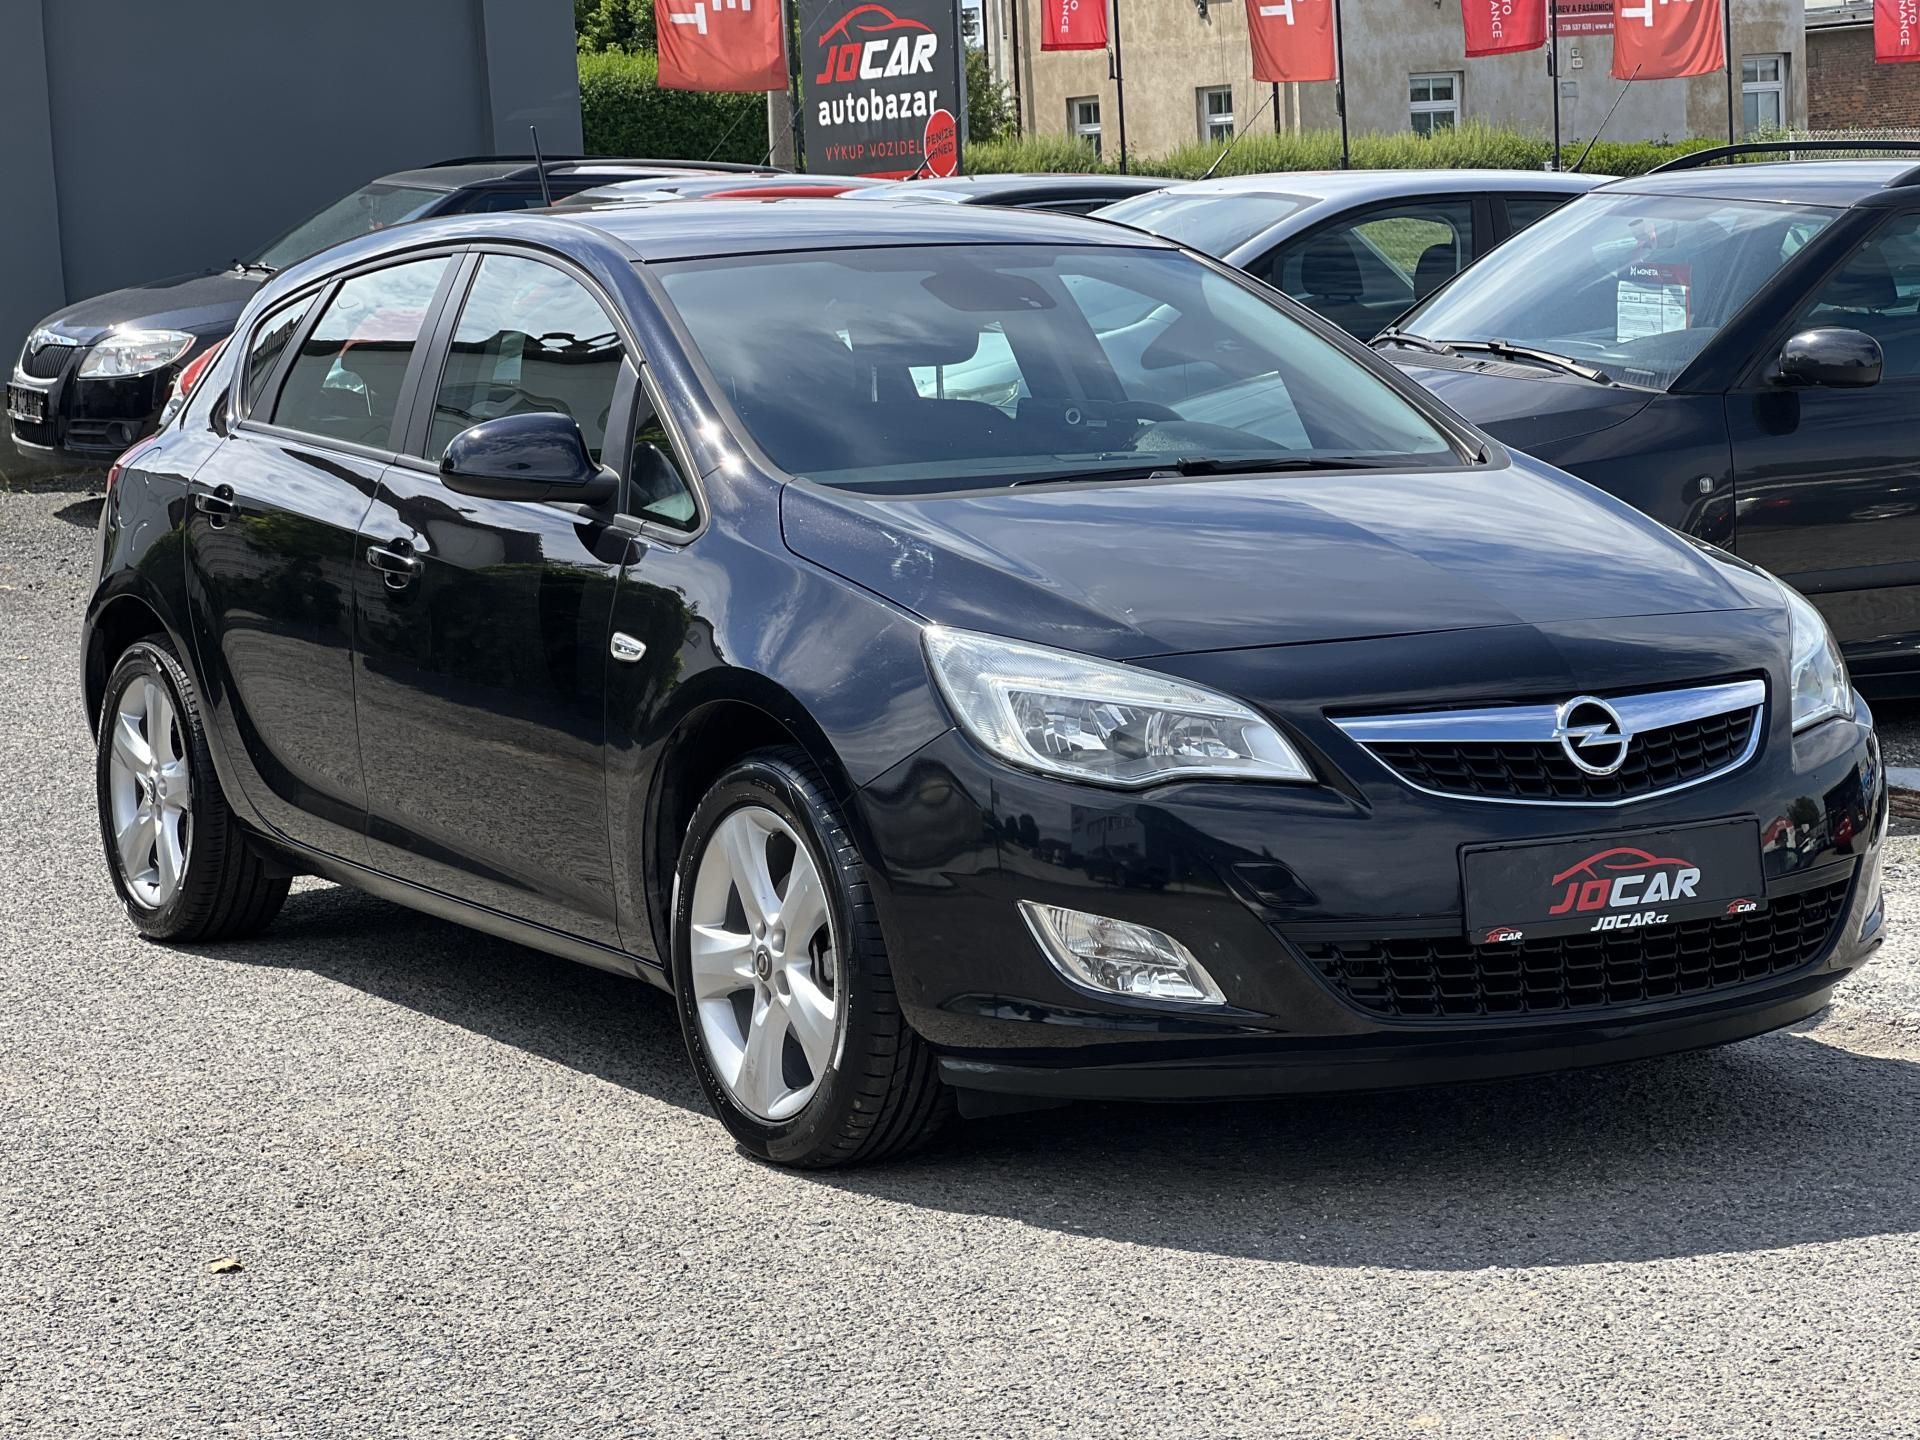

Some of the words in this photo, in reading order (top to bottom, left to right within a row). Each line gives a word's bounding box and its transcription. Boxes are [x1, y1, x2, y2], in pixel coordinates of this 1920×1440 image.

[816, 33, 938, 84] JOCAR
[818, 88, 938, 126] autobazar
[825, 143, 864, 160] VÝKUP
[869, 139, 923, 157] VOZIDEL
[1549, 867, 1700, 915] JOCAR
[1727, 902, 1757, 914] JOCAR
[1590, 911, 1669, 932] JOCAR.cz
[1485, 931, 1523, 943] JOCAR
